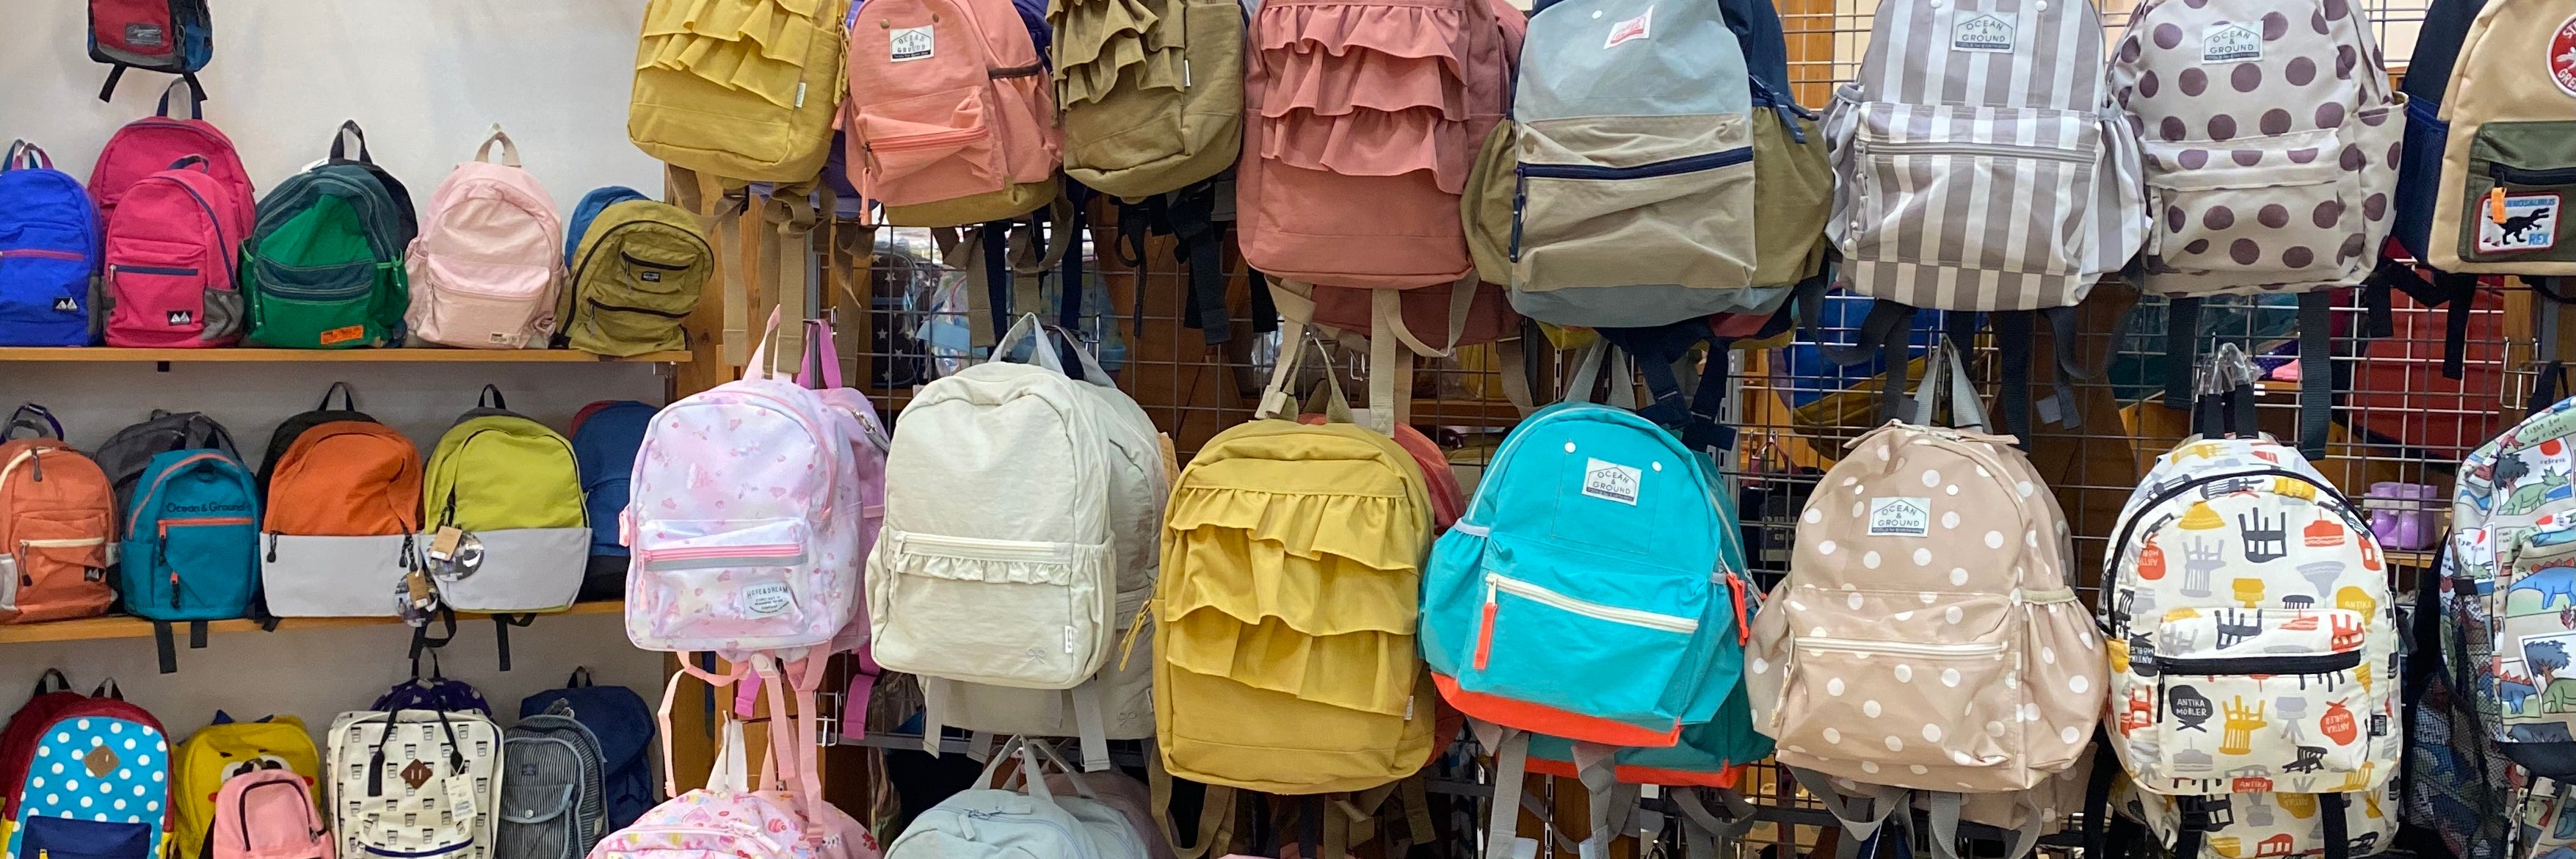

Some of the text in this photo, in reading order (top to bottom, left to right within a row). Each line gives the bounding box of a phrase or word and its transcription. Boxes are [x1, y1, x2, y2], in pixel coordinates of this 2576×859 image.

[1966, 19, 2003, 31] OCEAN
[1962, 34, 2006, 43] GROUND
[2213, 31, 2251, 43] OCEAN
[2210, 44, 2254, 54] GROUND
[2528, 232, 2550, 246] REX
[1597, 471, 1630, 484] OCEAN
[1592, 481, 1631, 495] GROUND
[166, 502, 200, 512] Ocean
[208, 501, 245, 512] Ground
[1882, 505, 1918, 516] OCEAN
[2130, 655, 2153, 664] ANTIK
[2177, 698, 2205, 707] ANTIKA
